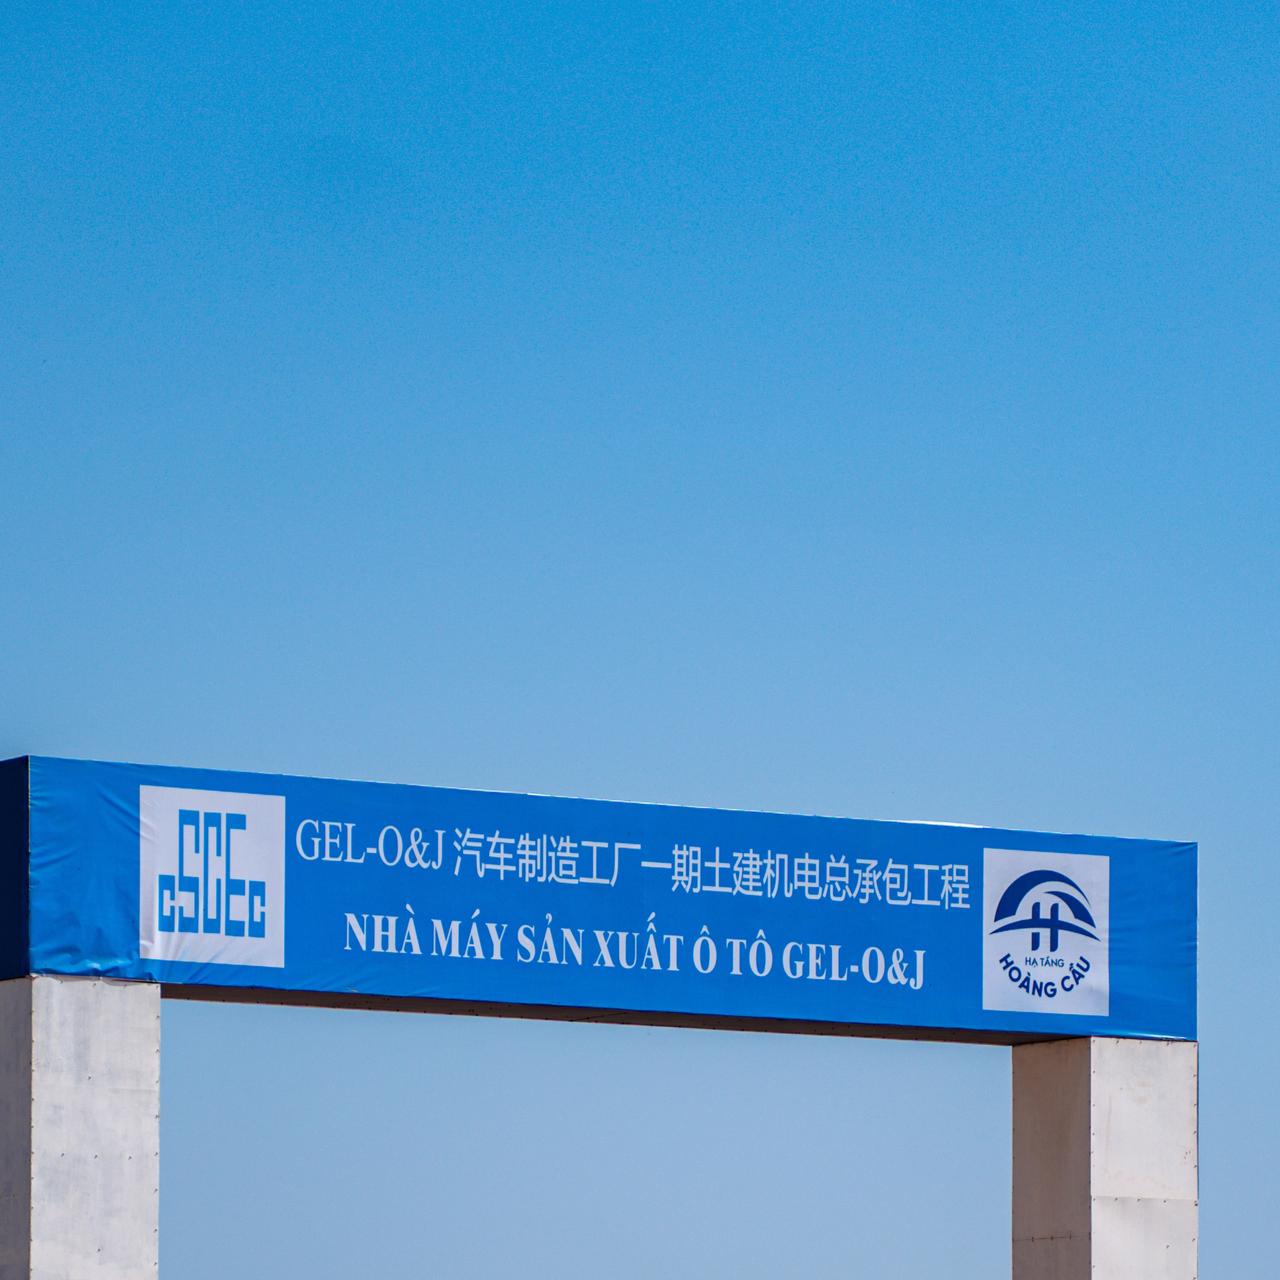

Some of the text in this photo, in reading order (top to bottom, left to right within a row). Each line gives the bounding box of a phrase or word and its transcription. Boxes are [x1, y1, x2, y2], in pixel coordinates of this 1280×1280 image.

[295, 818, 971, 910] GEL-O&J 汽车制造工厂一期土建机电总承包工程
[343, 903, 926, 990] NHÀ MÁY SẢN XUẤT Ô TÔ GEL-O&J
[999, 953, 1057, 998] HOÀNG
[1024, 956, 1039, 968] HẠ
